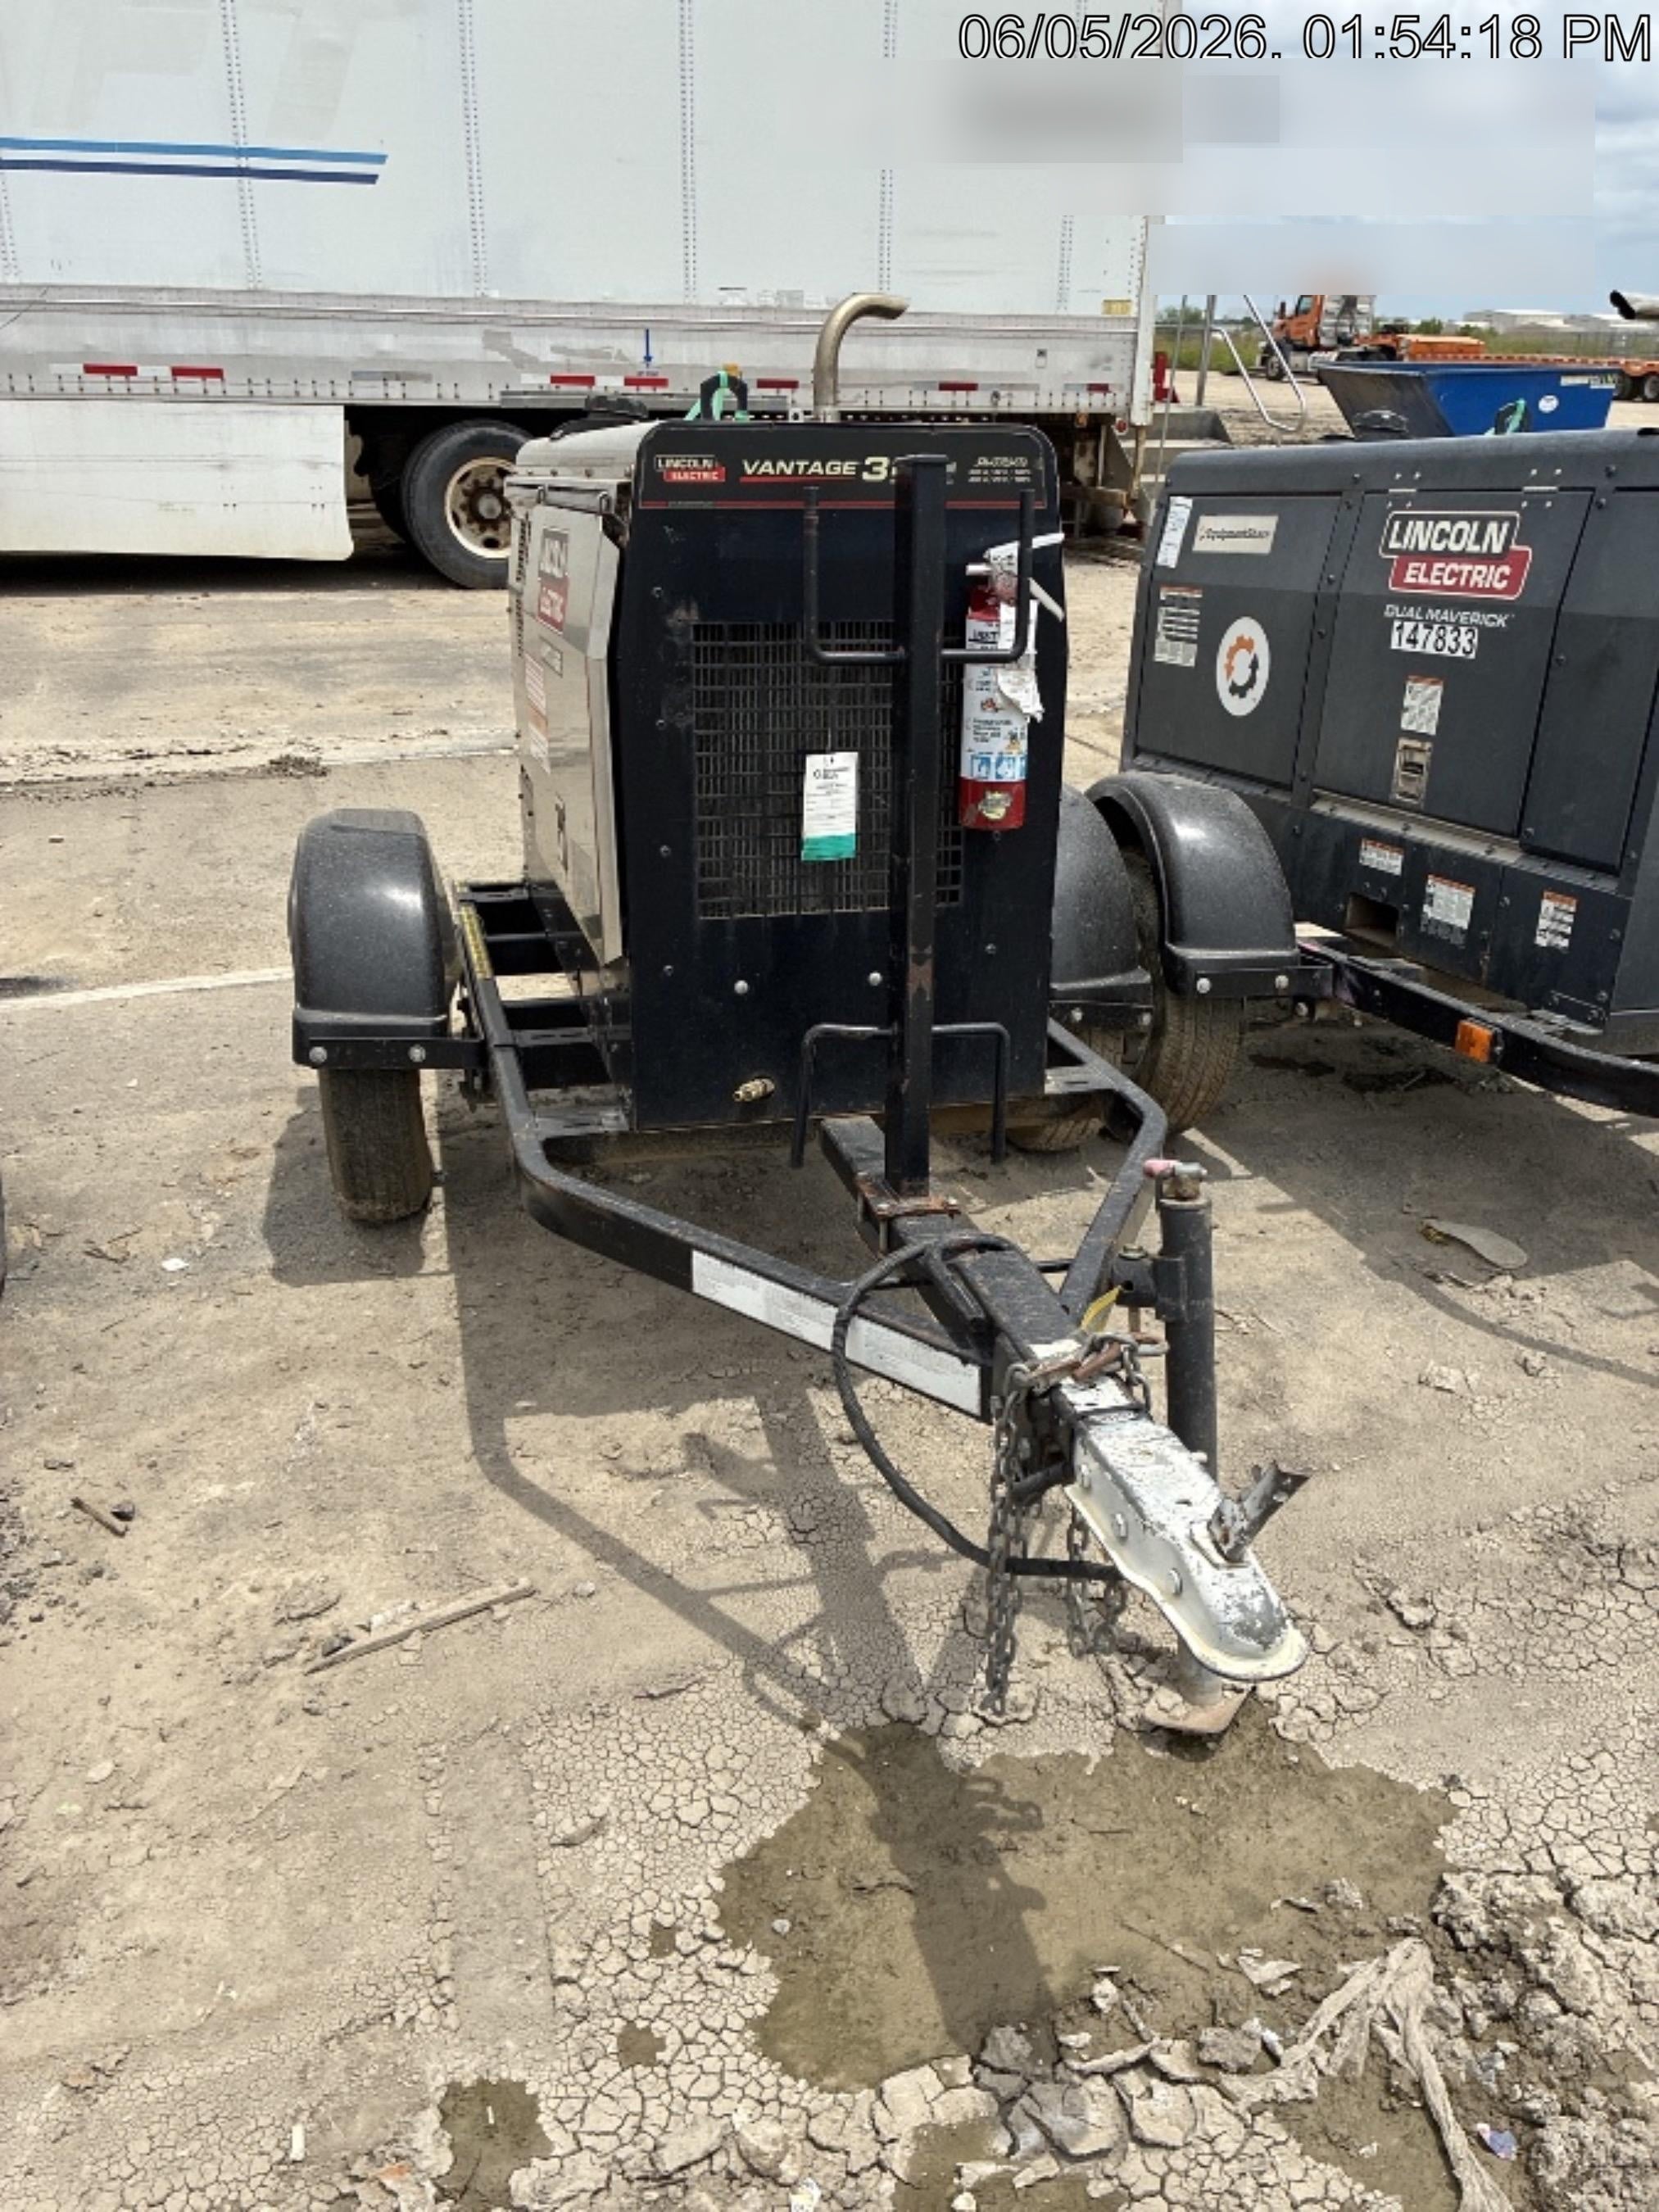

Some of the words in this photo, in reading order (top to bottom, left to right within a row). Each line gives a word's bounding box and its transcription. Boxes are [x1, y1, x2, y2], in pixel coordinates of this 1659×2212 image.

[658, 458, 714, 469] LINCOLN
[741, 460, 859, 476] VANTAGE
[1388, 519, 1511, 555] LINCOLN
[1403, 561, 1512, 590] ELECTRIC
[1383, 604, 1424, 621] DUAL
[1394, 622, 1477, 656] 147833
